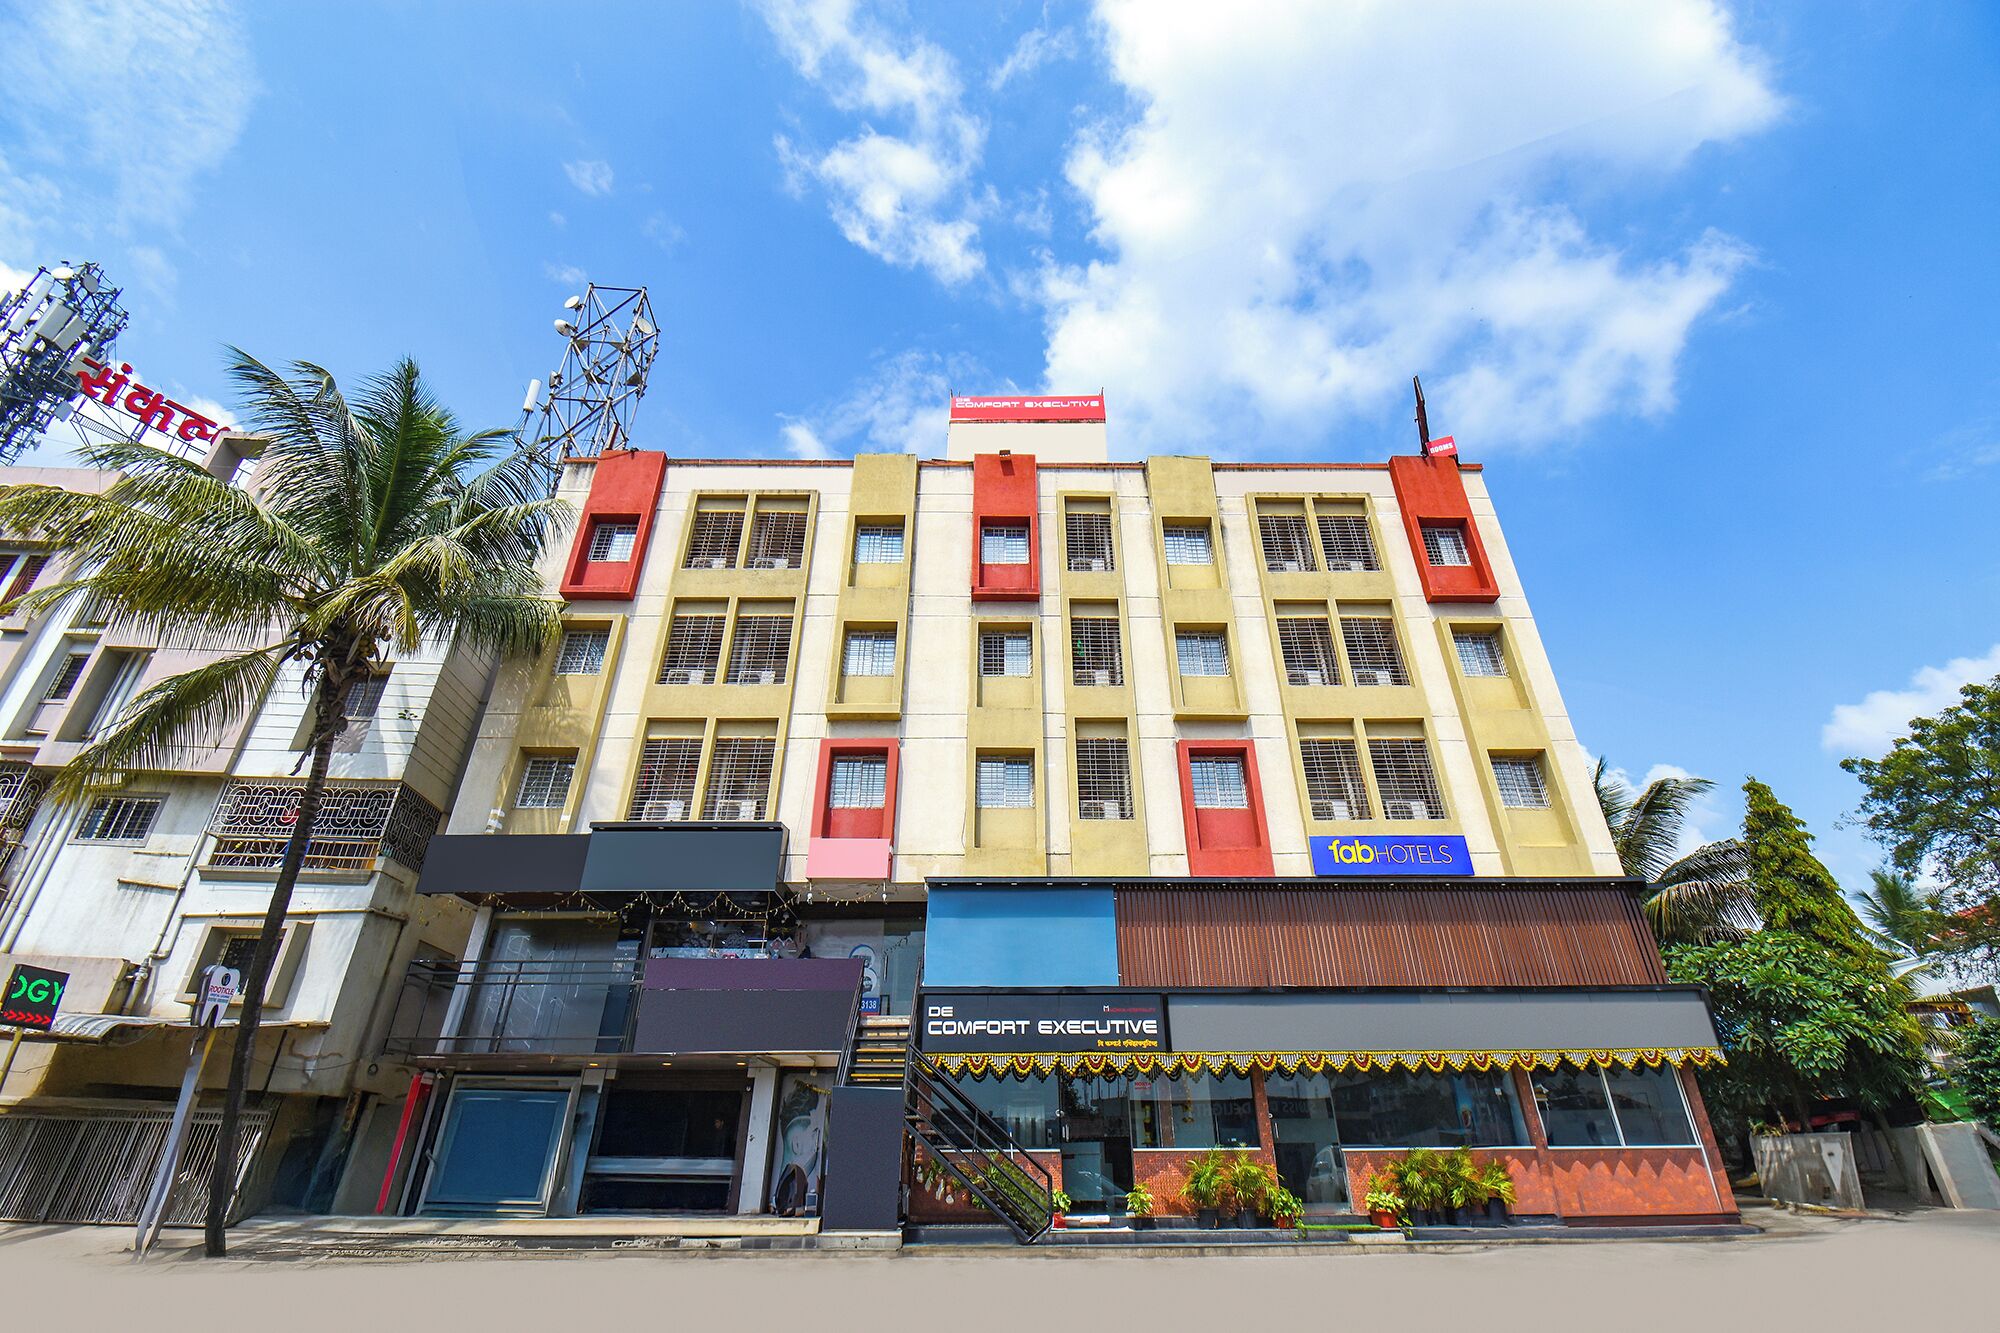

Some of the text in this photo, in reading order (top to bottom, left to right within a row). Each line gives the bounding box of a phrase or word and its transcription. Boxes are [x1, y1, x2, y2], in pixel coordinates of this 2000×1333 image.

[1024, 400, 1100, 408] EXECUTIVE
[928, 1006, 954, 1017] DE
[928, 1019, 1158, 1035] COMFORT EXECUTIVE
